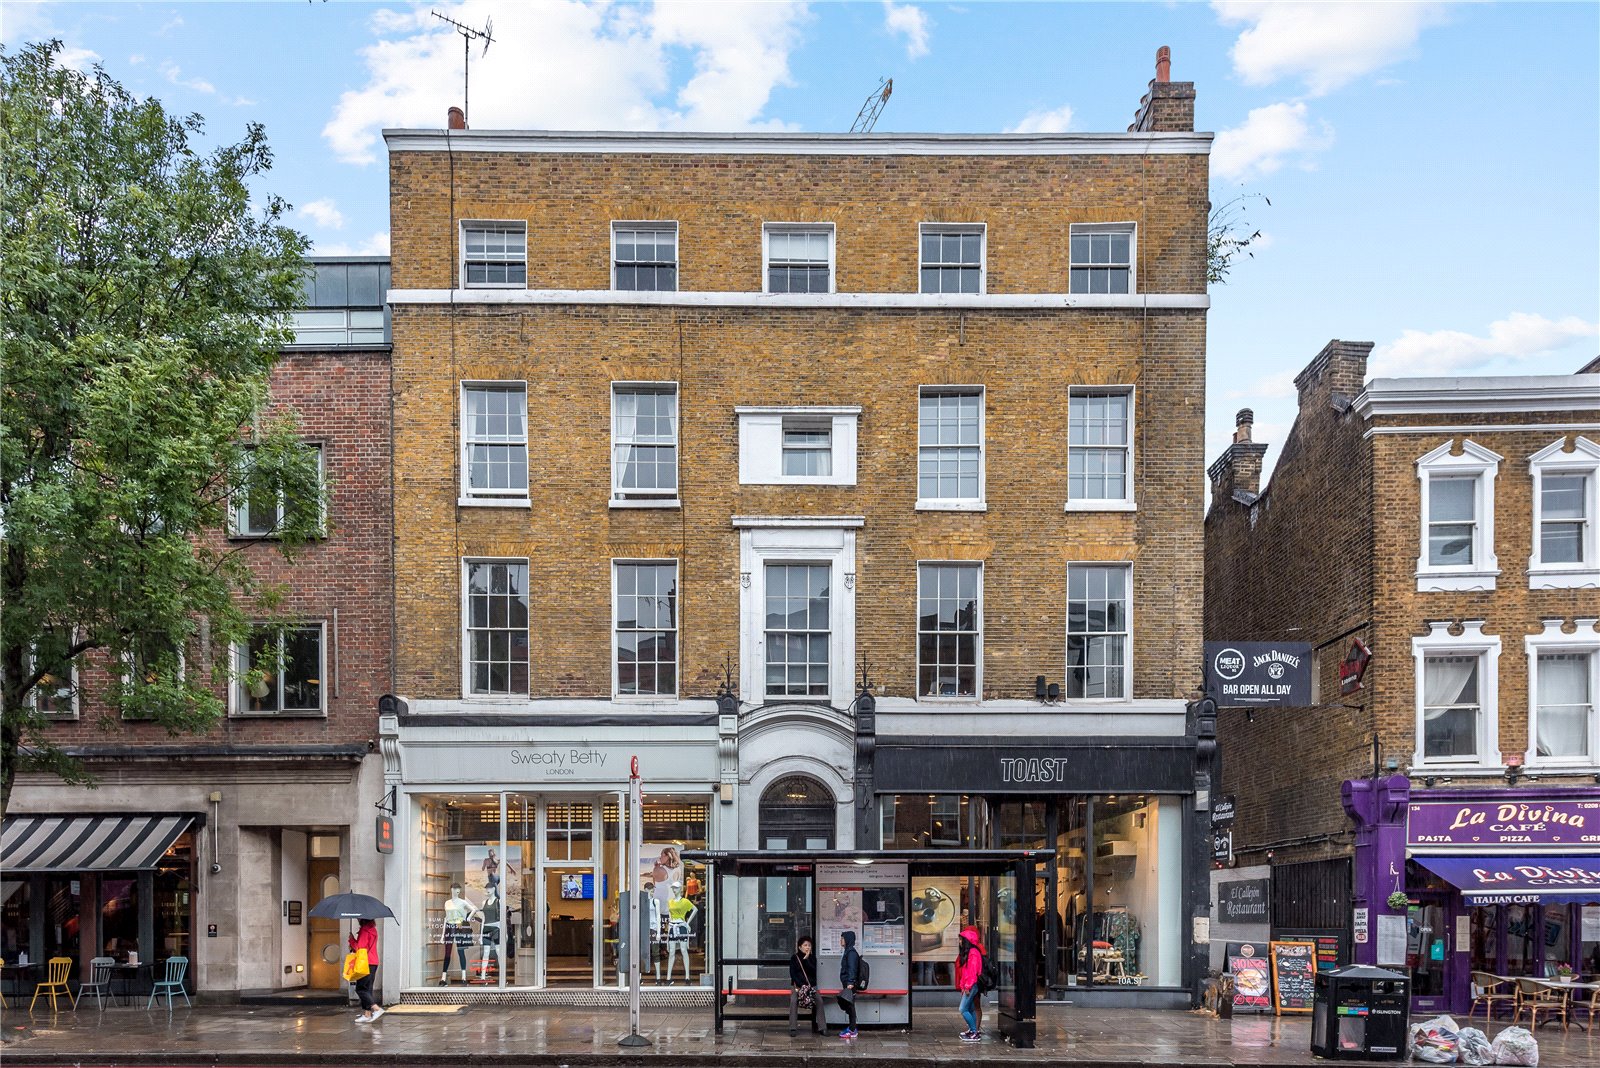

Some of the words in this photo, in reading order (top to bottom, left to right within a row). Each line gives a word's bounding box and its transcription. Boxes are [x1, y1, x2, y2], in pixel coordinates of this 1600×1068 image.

[1220, 657, 1241, 665] MEAT
[1253, 653, 1272, 668] JACK
[1223, 684, 1238, 694] BAR
[1240, 684, 1260, 694] OPEN
[1261, 684, 1275, 694] ALL
[1276, 684, 1292, 694] DAY
[510, 750, 566, 767] Sweaty
[570, 750, 608, 767] Betty
[1000, 758, 1068, 782] TOAST
[1212, 810, 1234, 822] Restaurant
[1450, 808, 1486, 830] La
[1497, 804, 1584, 828] Divina
[1489, 821, 1547, 832] CAFÉ
[1472, 868, 1512, 883] La
[1231, 887, 1238, 899] El
[1226, 902, 1266, 917] Restaurant
[1118, 977, 1142, 985] TOA.ST
